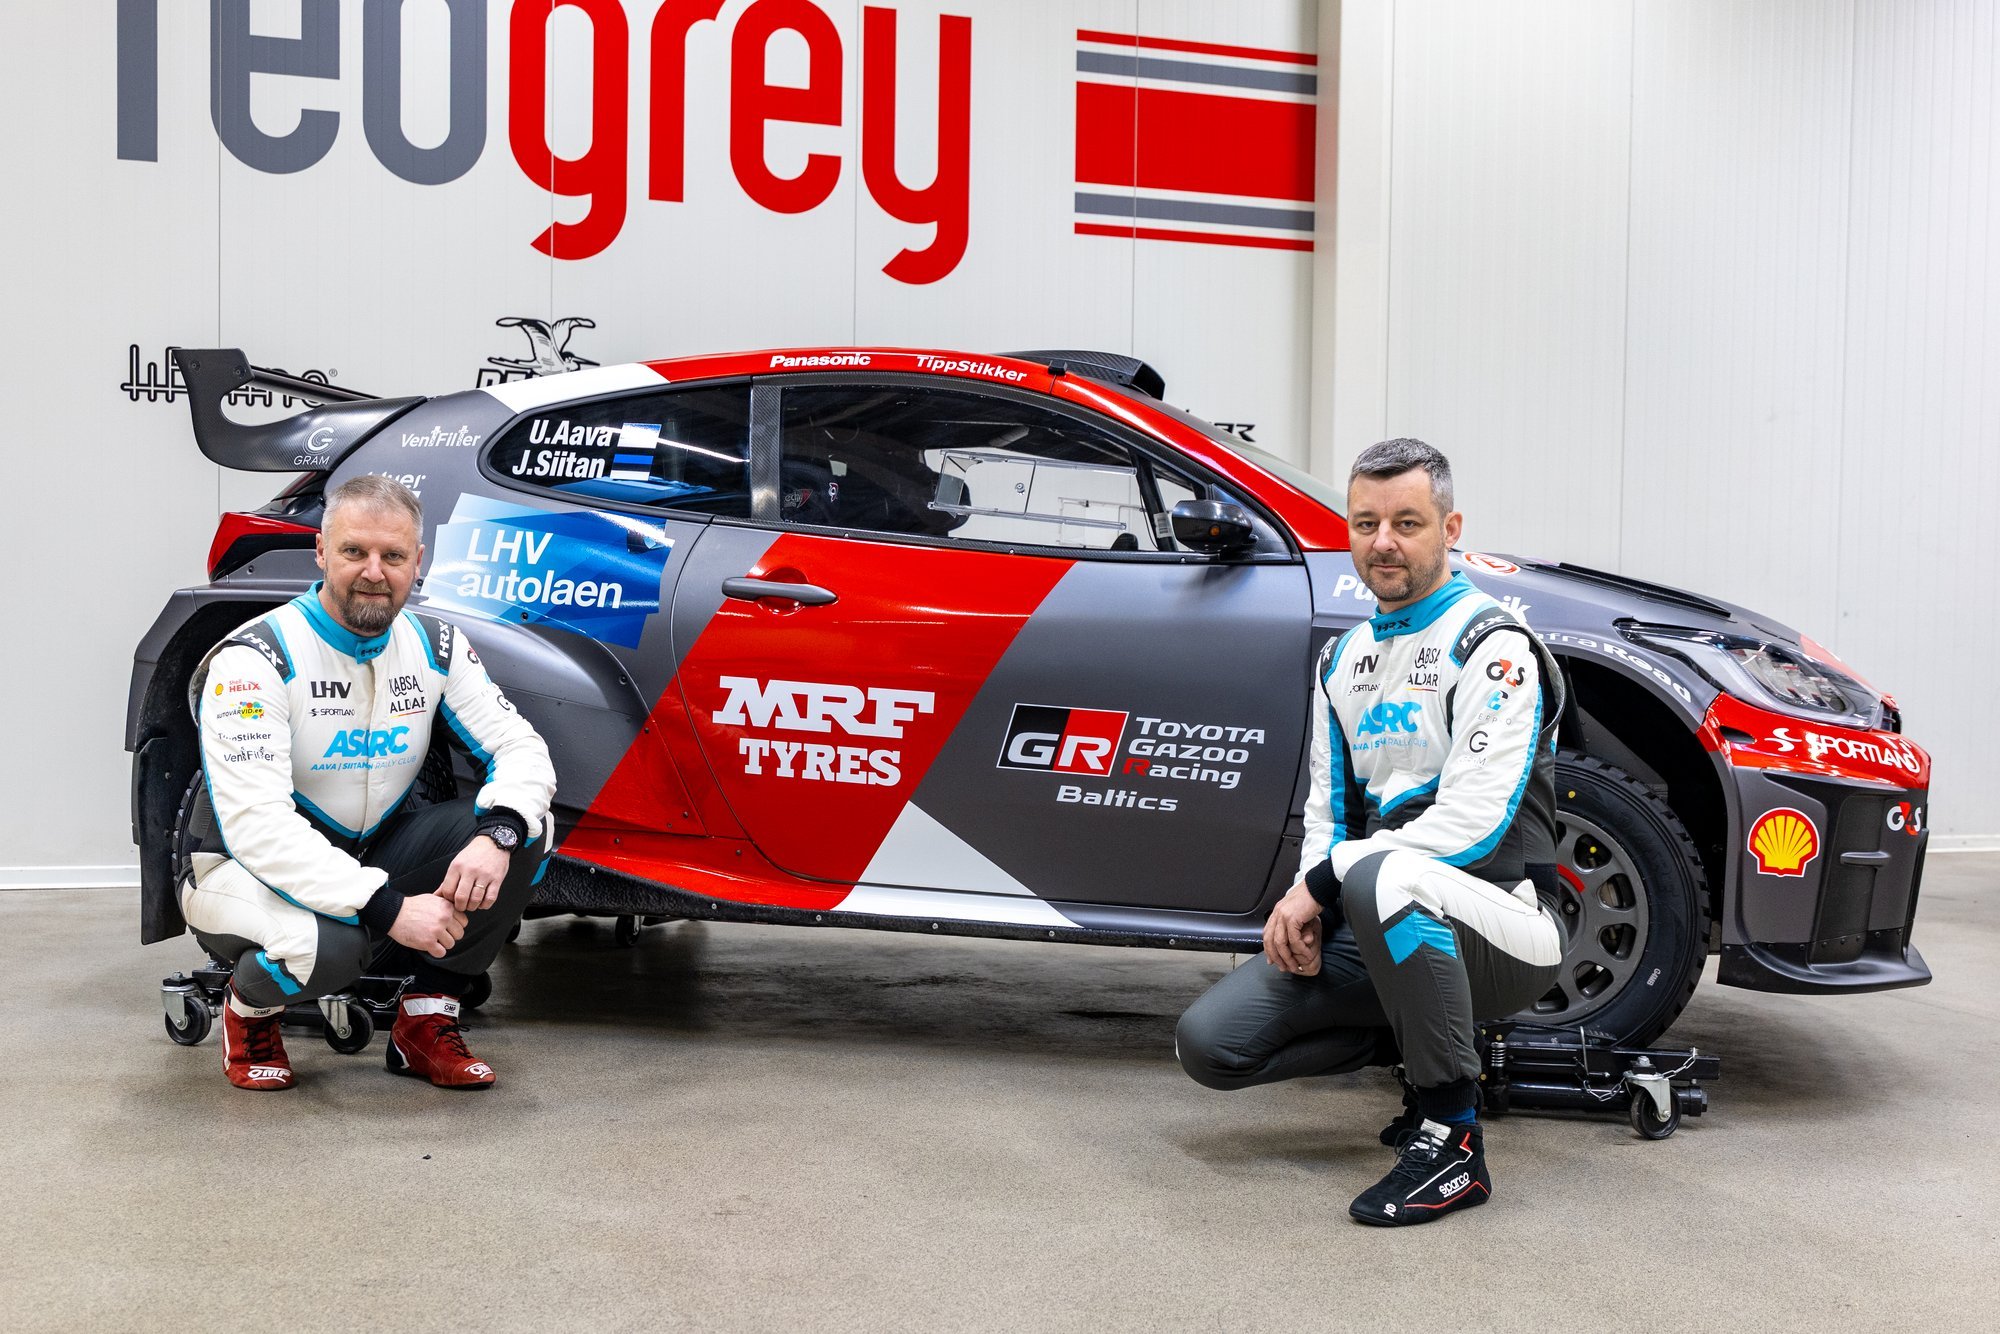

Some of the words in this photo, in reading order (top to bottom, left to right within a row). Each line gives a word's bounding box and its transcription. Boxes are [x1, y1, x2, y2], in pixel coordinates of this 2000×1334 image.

[769, 353, 872, 368] Panasonic
[917, 356, 1028, 383] TippStikker
[401, 424, 481, 448] VentFilter
[529, 419, 614, 448] U.Aava
[293, 455, 330, 466] GRAM
[512, 449, 606, 479] J.Siitan
[466, 528, 554, 565] LHV
[456, 569, 623, 609] autolaen
[241, 632, 284, 667] HRX
[438, 620, 450, 659] HRX
[1603, 641, 1692, 703] Road
[229, 682, 262, 693] HELIX
[310, 680, 352, 699] LHV
[712, 675, 935, 739] MRF
[1135, 716, 1265, 745] TOYOTA
[739, 737, 902, 787] TYRES
[1007, 731, 1112, 771] GR
[1128, 738, 1250, 764] GAZOO
[311, 763, 337, 771] AAVA
[1122, 757, 1242, 790] Racing
[1056, 784, 1179, 812] Baltics
[248, 1067, 292, 1079] OMP
[1438, 1171, 1470, 1197] sparco
